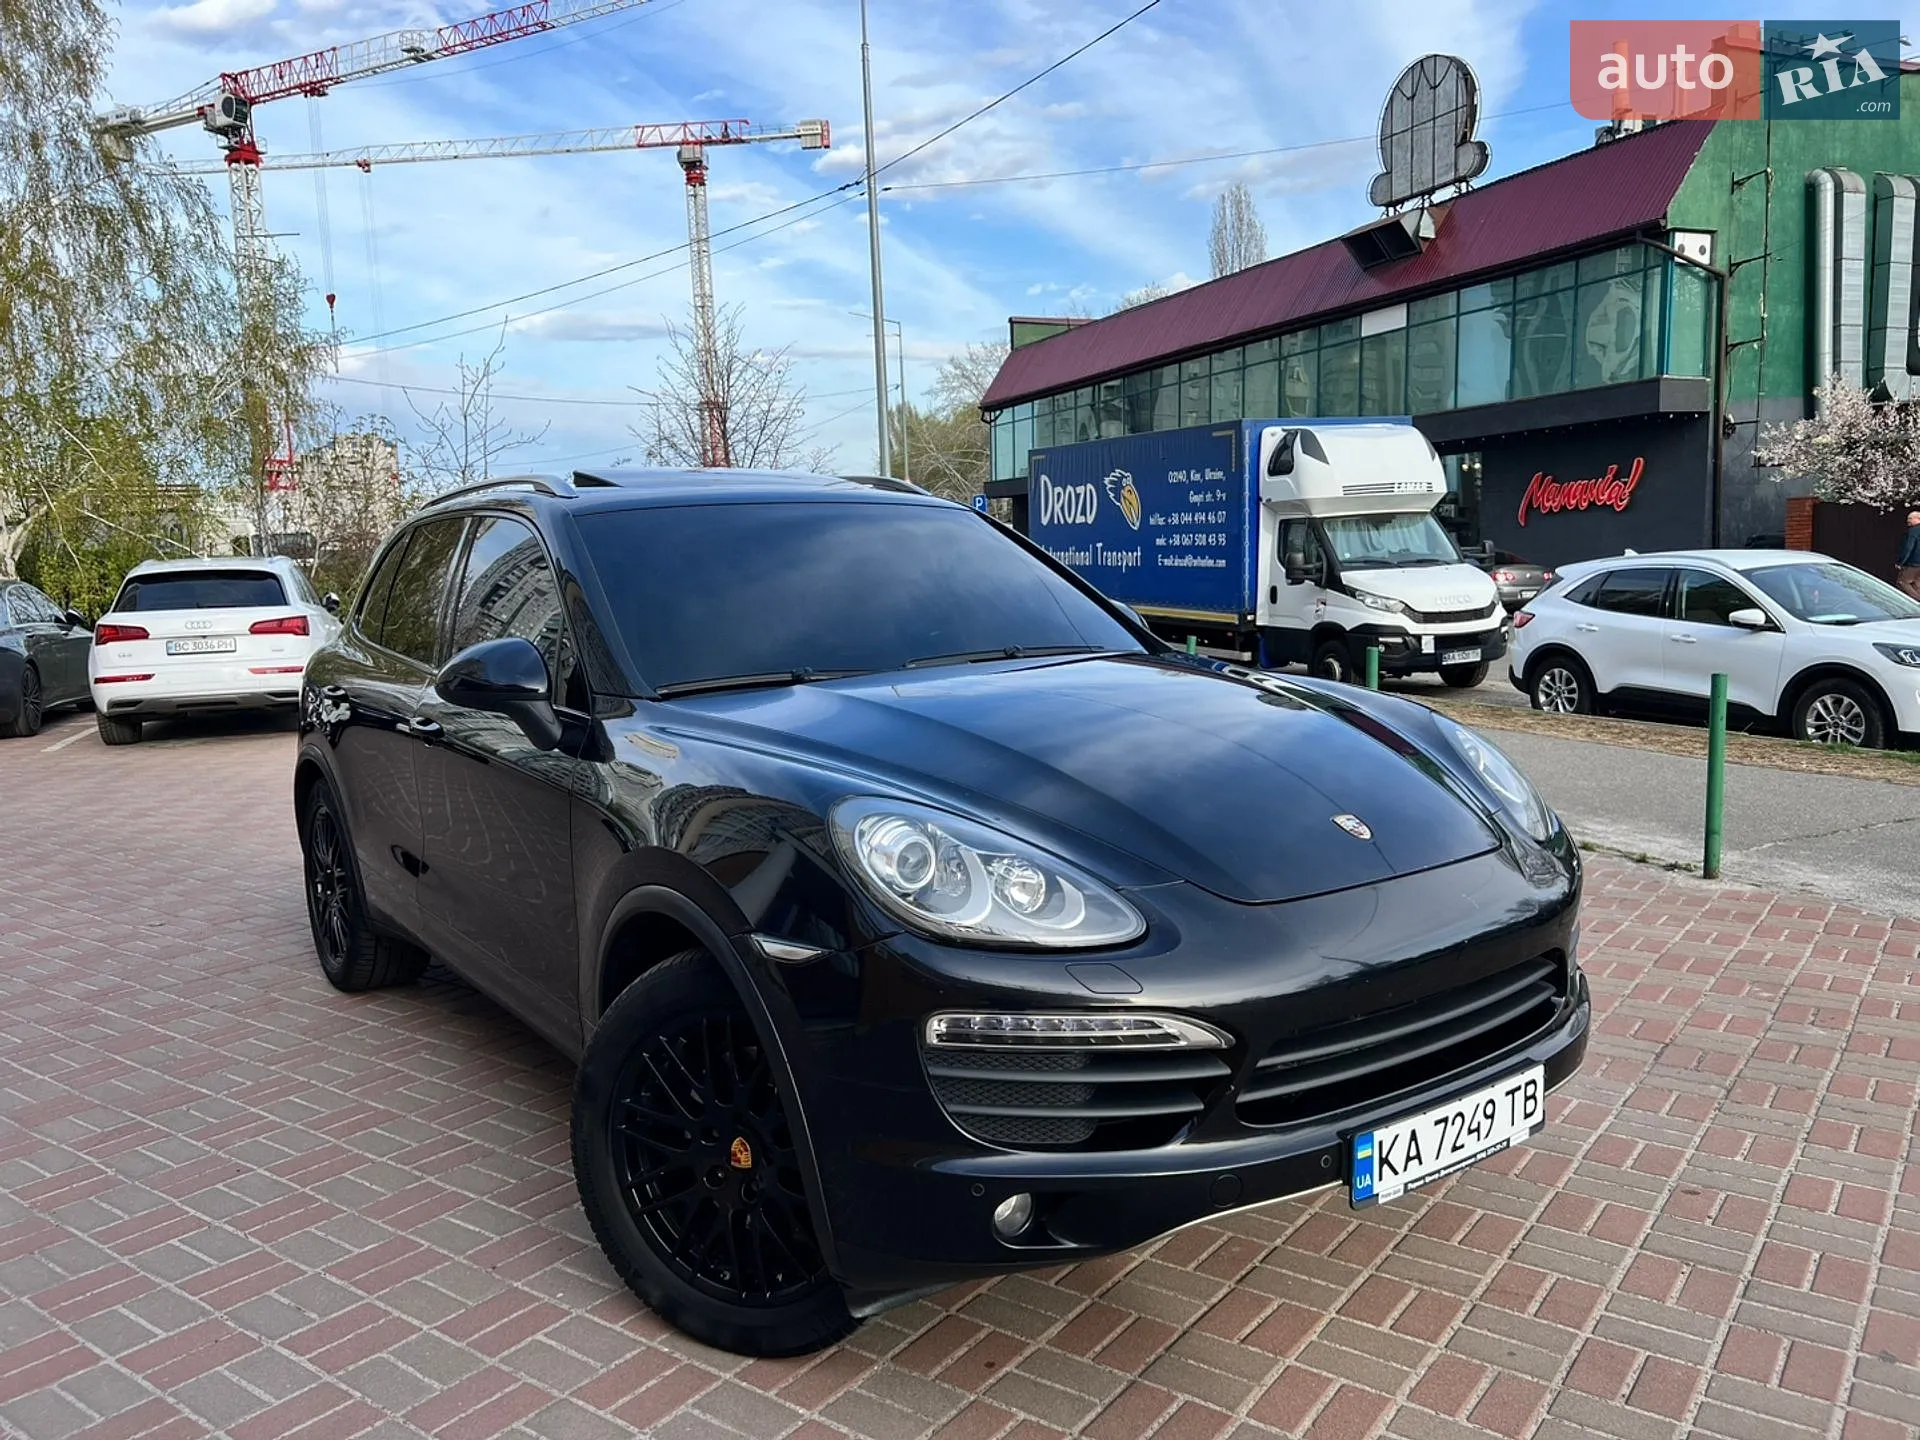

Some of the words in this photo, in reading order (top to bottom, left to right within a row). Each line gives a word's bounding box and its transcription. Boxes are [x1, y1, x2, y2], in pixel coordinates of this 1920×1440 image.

[1040, 474, 1098, 526] DROZD
[1168, 512, 1180, 525] +38
[1180, 511, 1193, 525] 044
[1207, 511, 1216, 524] 46
[1217, 510, 1227, 524] 07
[1168, 533, 1180, 547] +38
[1181, 533, 1193, 546] 067
[1096, 542, 1141, 574] Transport
[191, 641, 216, 651] 3036
[1378, 1128, 1423, 1182] KA
[1434, 1098, 1496, 1160] 7249
[1505, 1078, 1538, 1128] TB
[1356, 1175, 1372, 1190] UA
